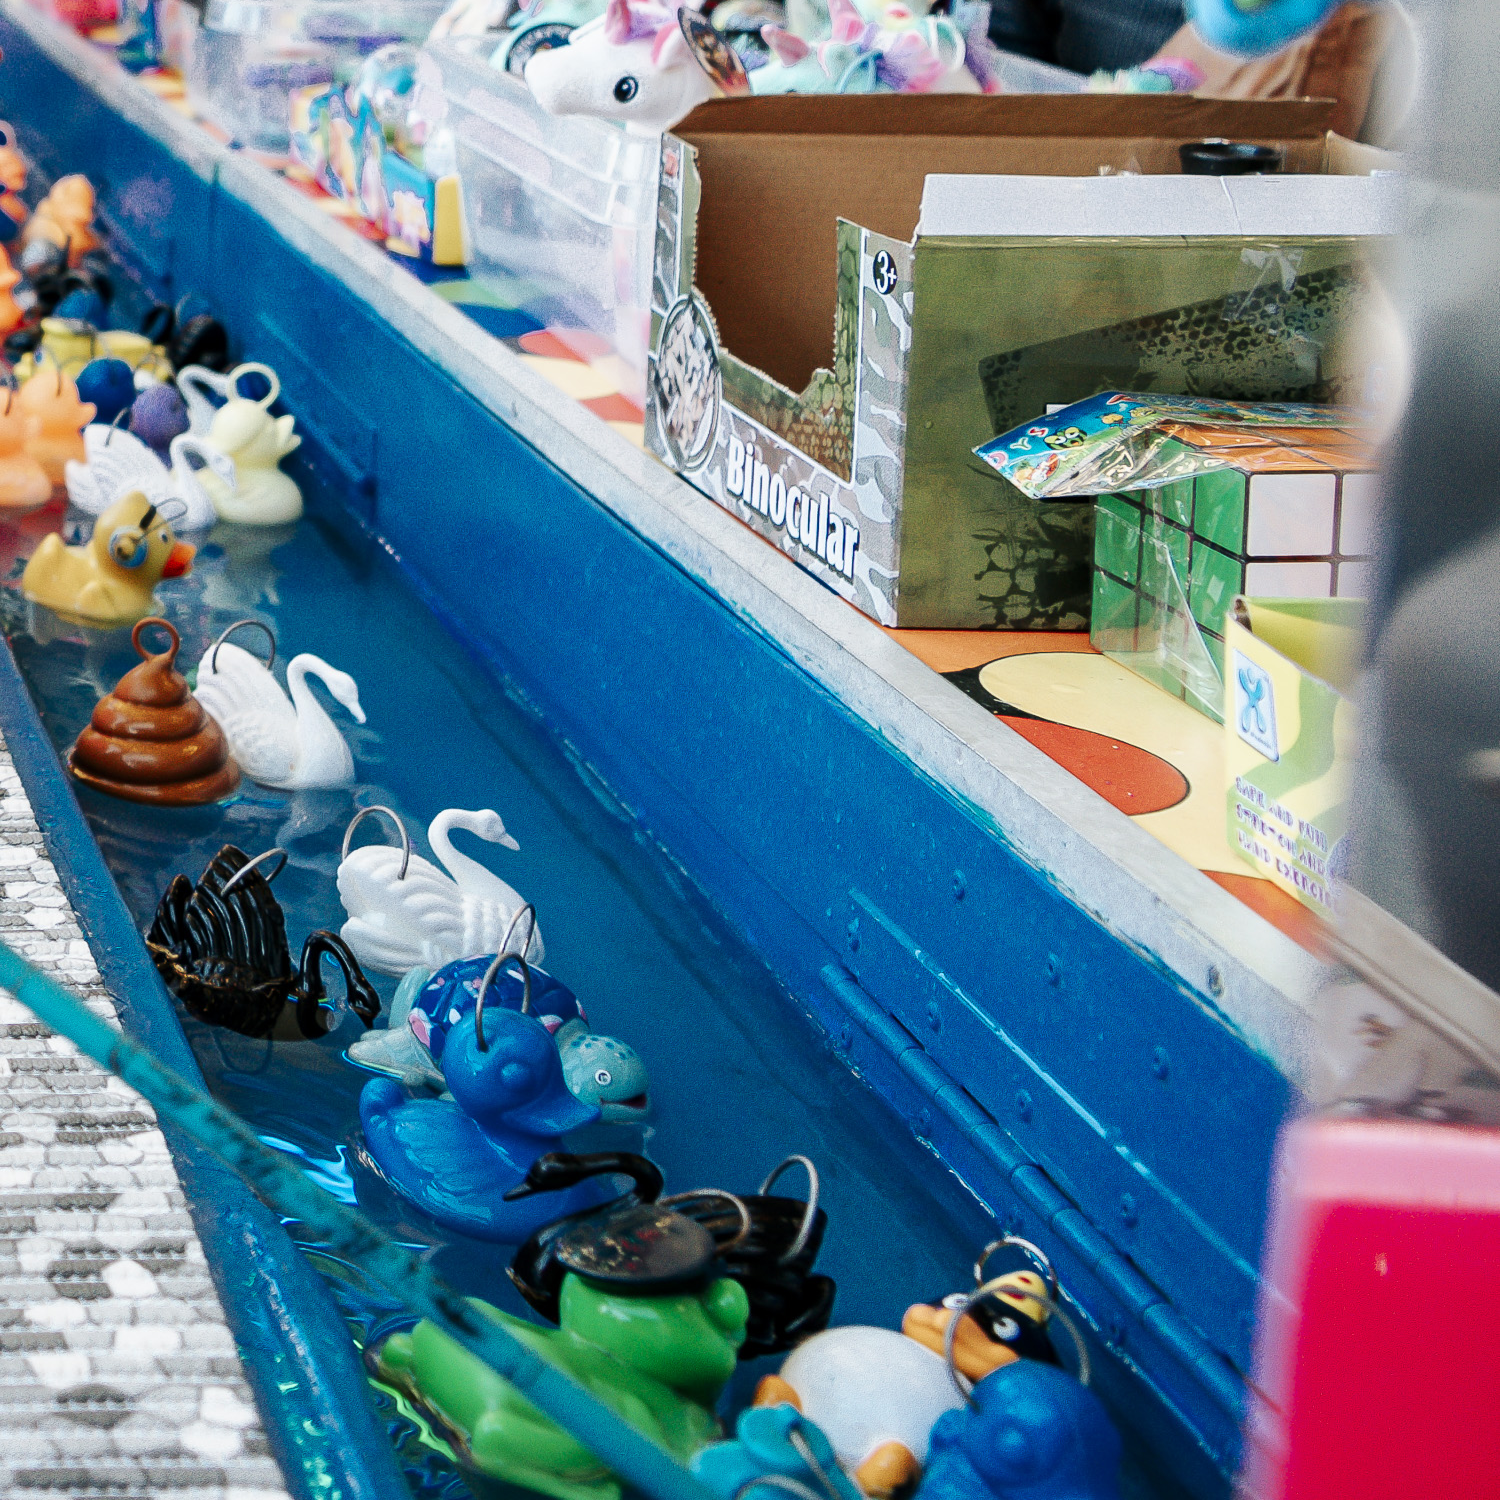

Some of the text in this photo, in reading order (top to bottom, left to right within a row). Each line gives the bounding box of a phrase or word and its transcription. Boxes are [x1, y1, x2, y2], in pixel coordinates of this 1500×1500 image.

[876, 250, 897, 294] 3+
[726, 434, 860, 580] Binocular
[1269, 803, 1293, 827] AND
